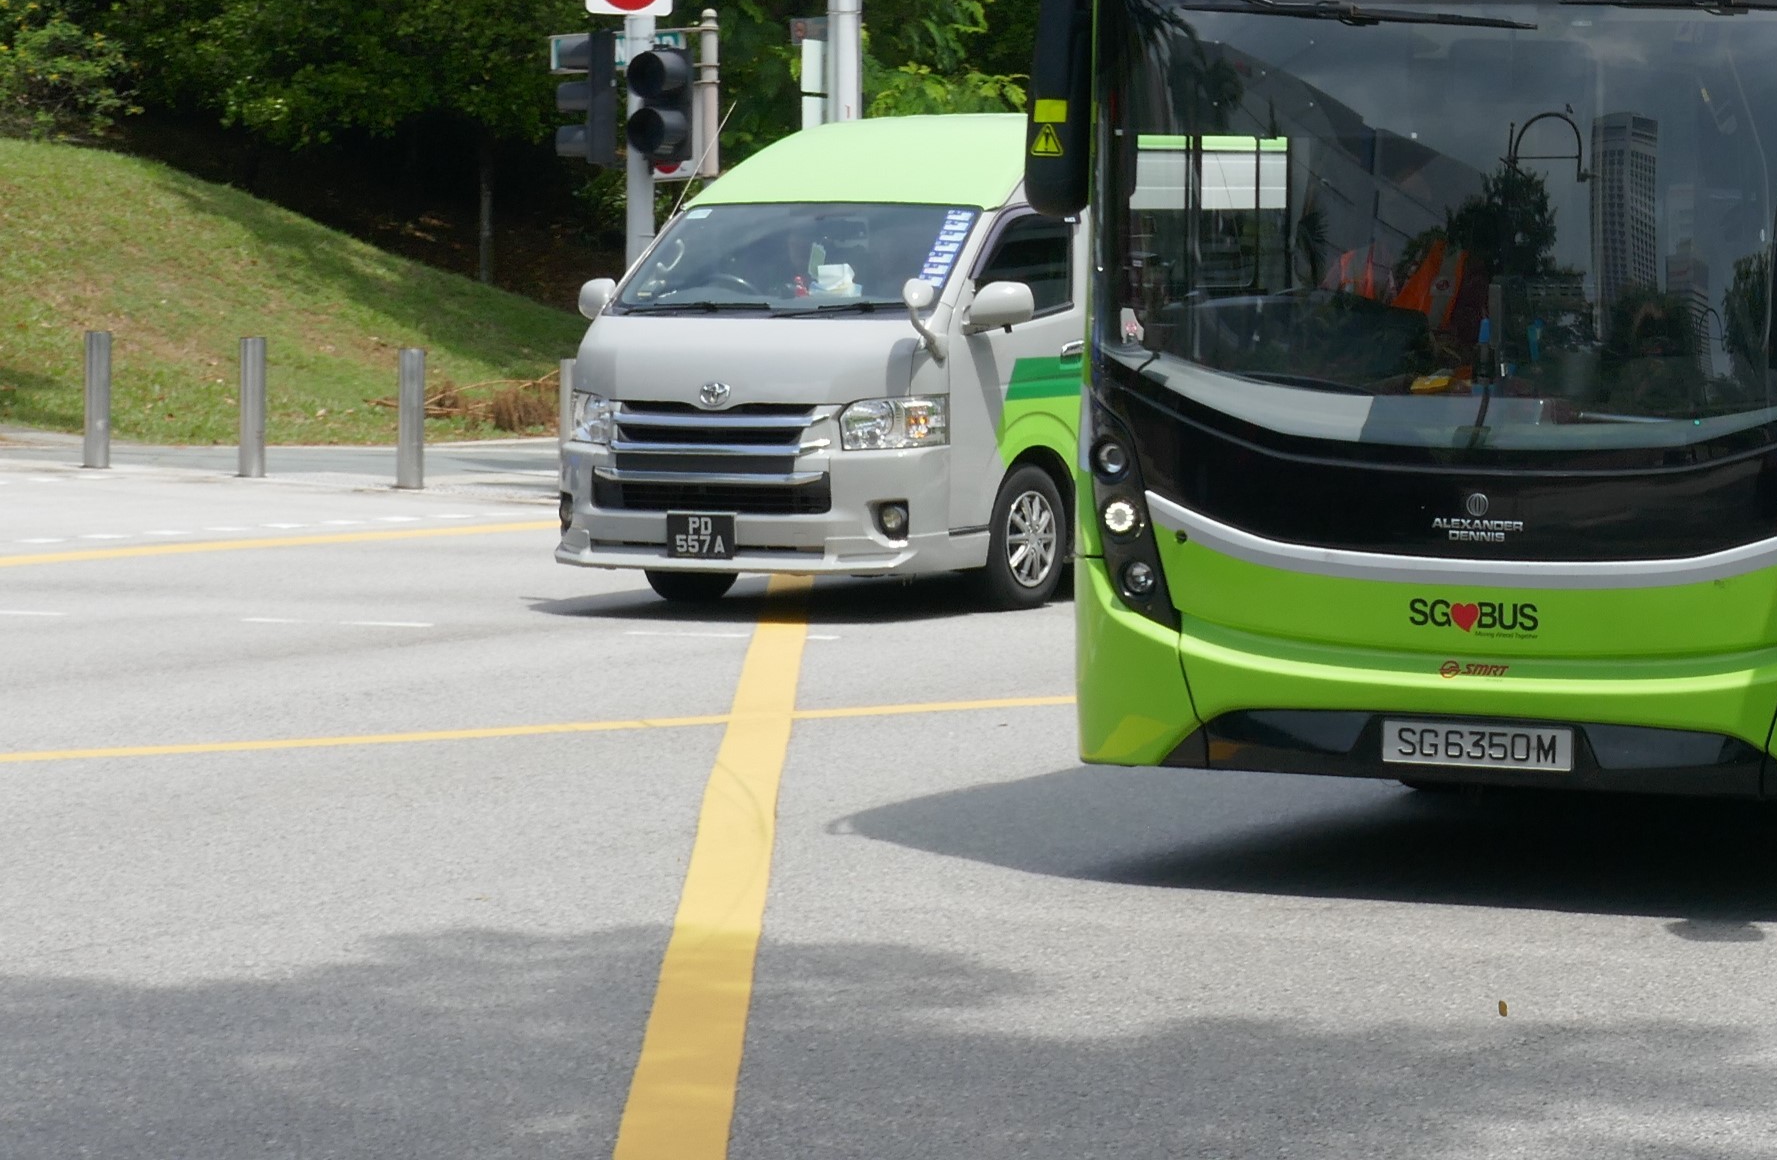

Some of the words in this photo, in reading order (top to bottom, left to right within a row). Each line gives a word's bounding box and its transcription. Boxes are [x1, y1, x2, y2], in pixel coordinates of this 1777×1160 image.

[688, 516, 712, 535] PD
[1432, 517, 1524, 532] ALEXANDER
[675, 534, 725, 553] 557A
[1449, 530, 1505, 542] DENNIS
[1461, 663, 1509, 677] SMRT
